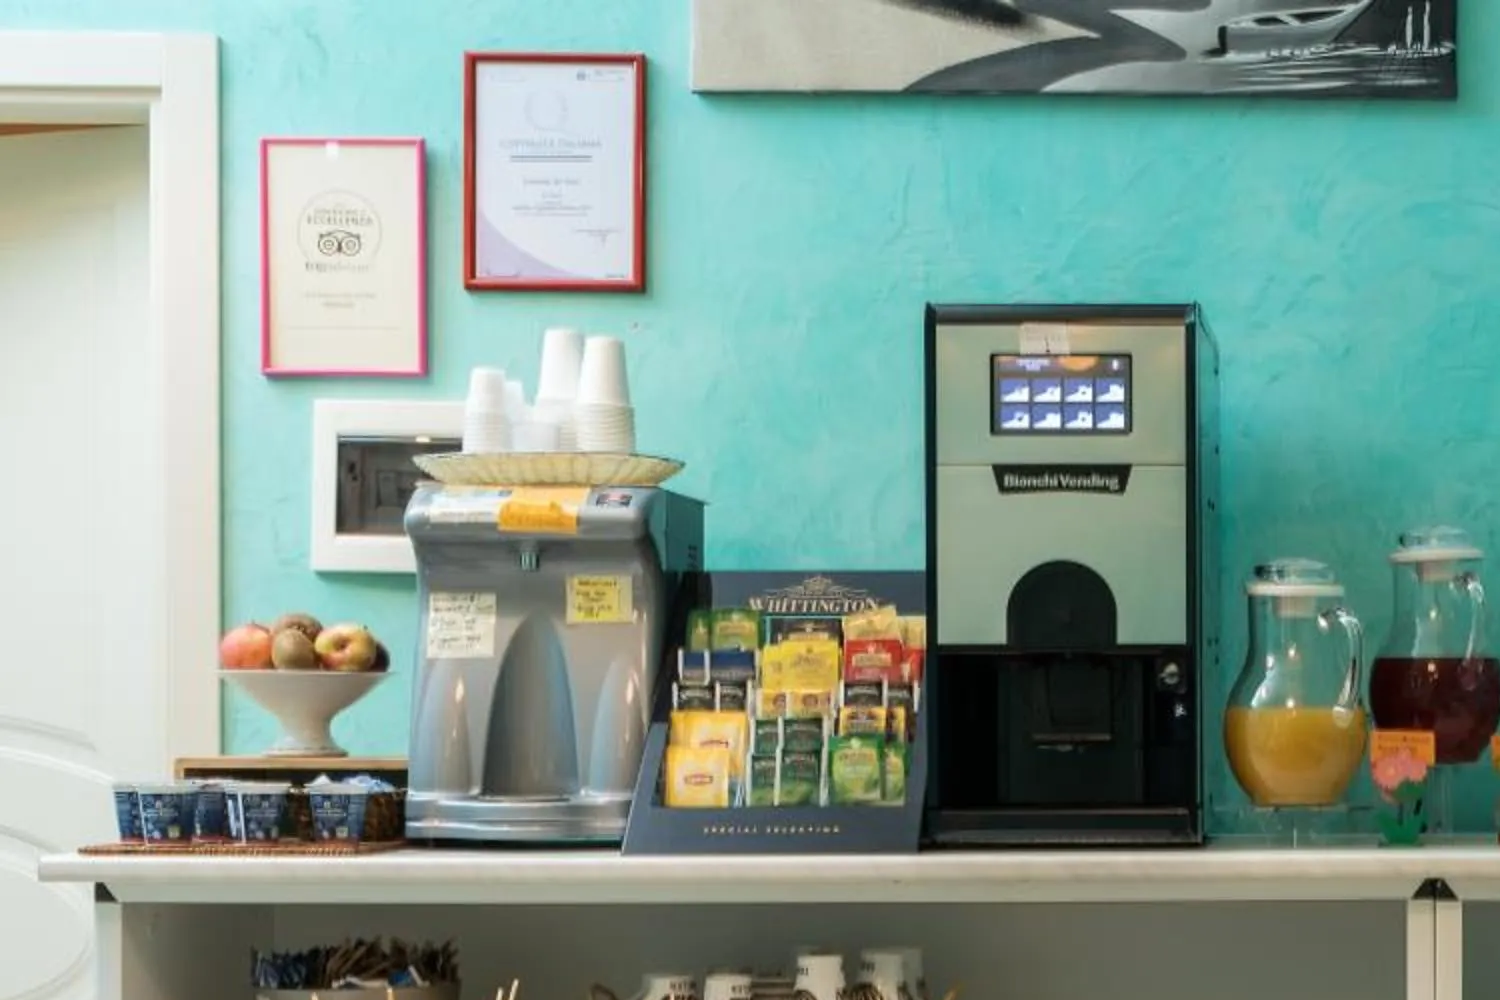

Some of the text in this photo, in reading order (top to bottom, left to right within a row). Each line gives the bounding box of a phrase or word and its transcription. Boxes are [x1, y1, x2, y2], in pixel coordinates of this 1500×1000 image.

[1003, 472, 1120, 491] Bianchi Vending
[749, 596, 879, 613] WHITTINGTON
